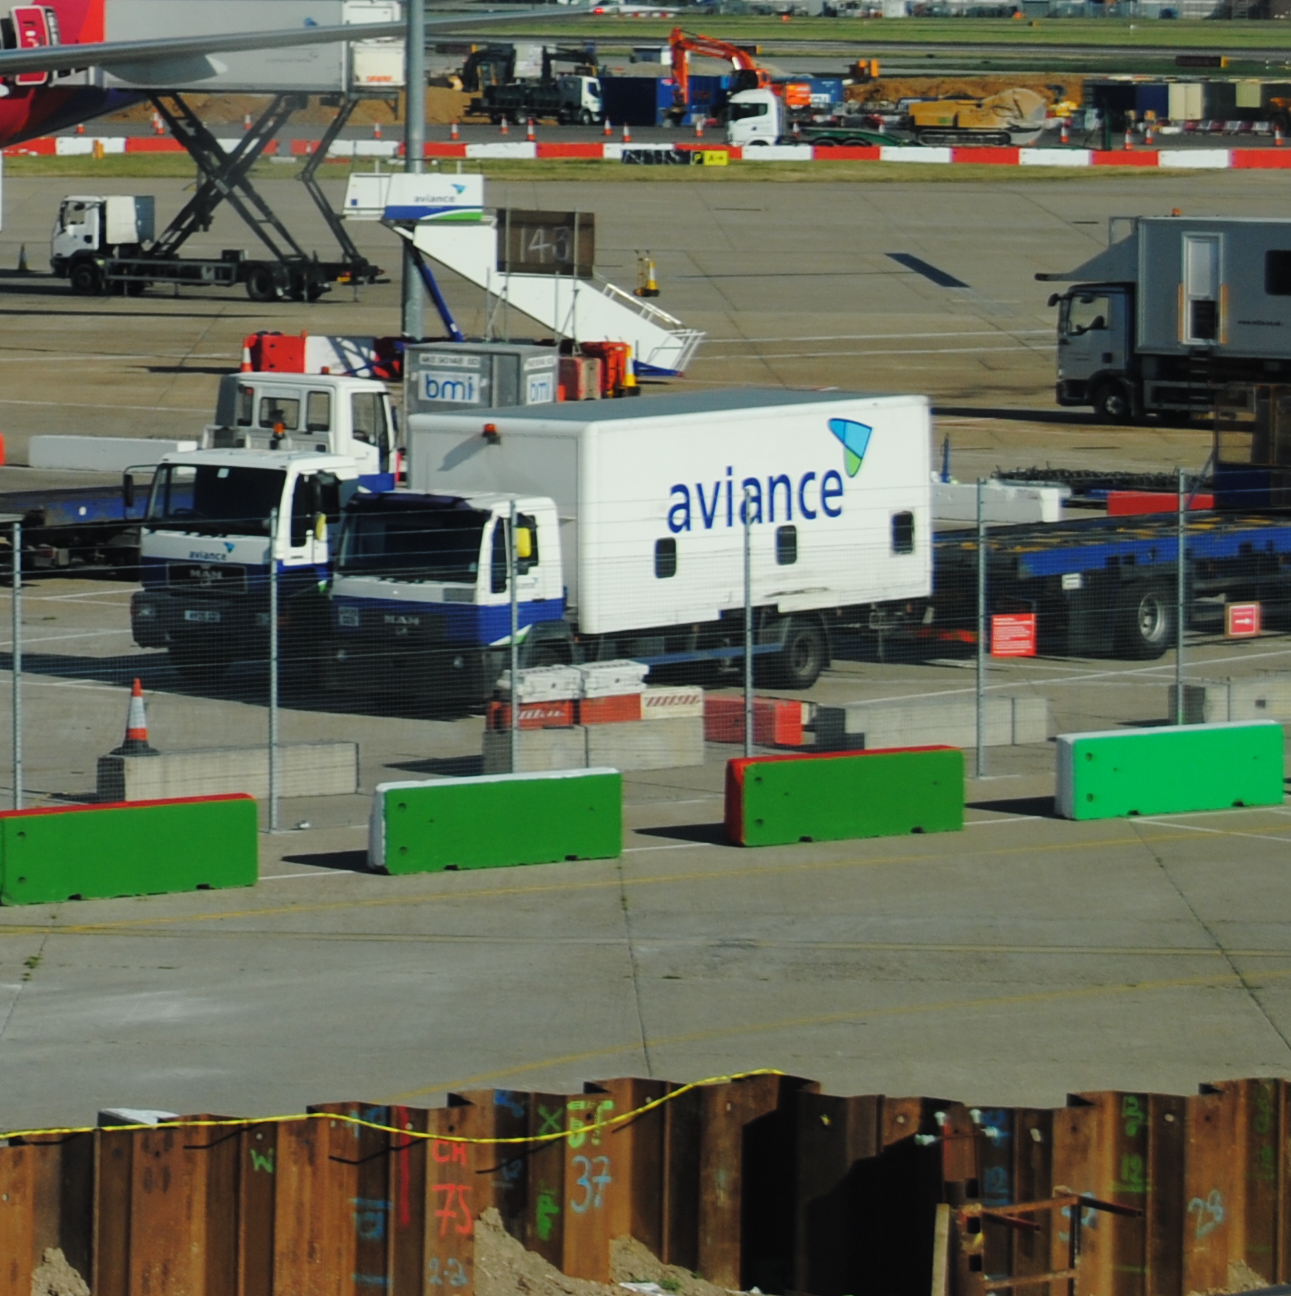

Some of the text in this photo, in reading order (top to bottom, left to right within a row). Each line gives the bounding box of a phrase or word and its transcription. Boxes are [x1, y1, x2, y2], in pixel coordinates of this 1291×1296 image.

[414, 194, 455, 204] aviance
[425, 373, 474, 401] bmi
[667, 465, 844, 534] aviance
[189, 551, 227, 561] aviance
[571, 1155, 612, 1213] 37
[432, 1183, 473, 1236] 75
